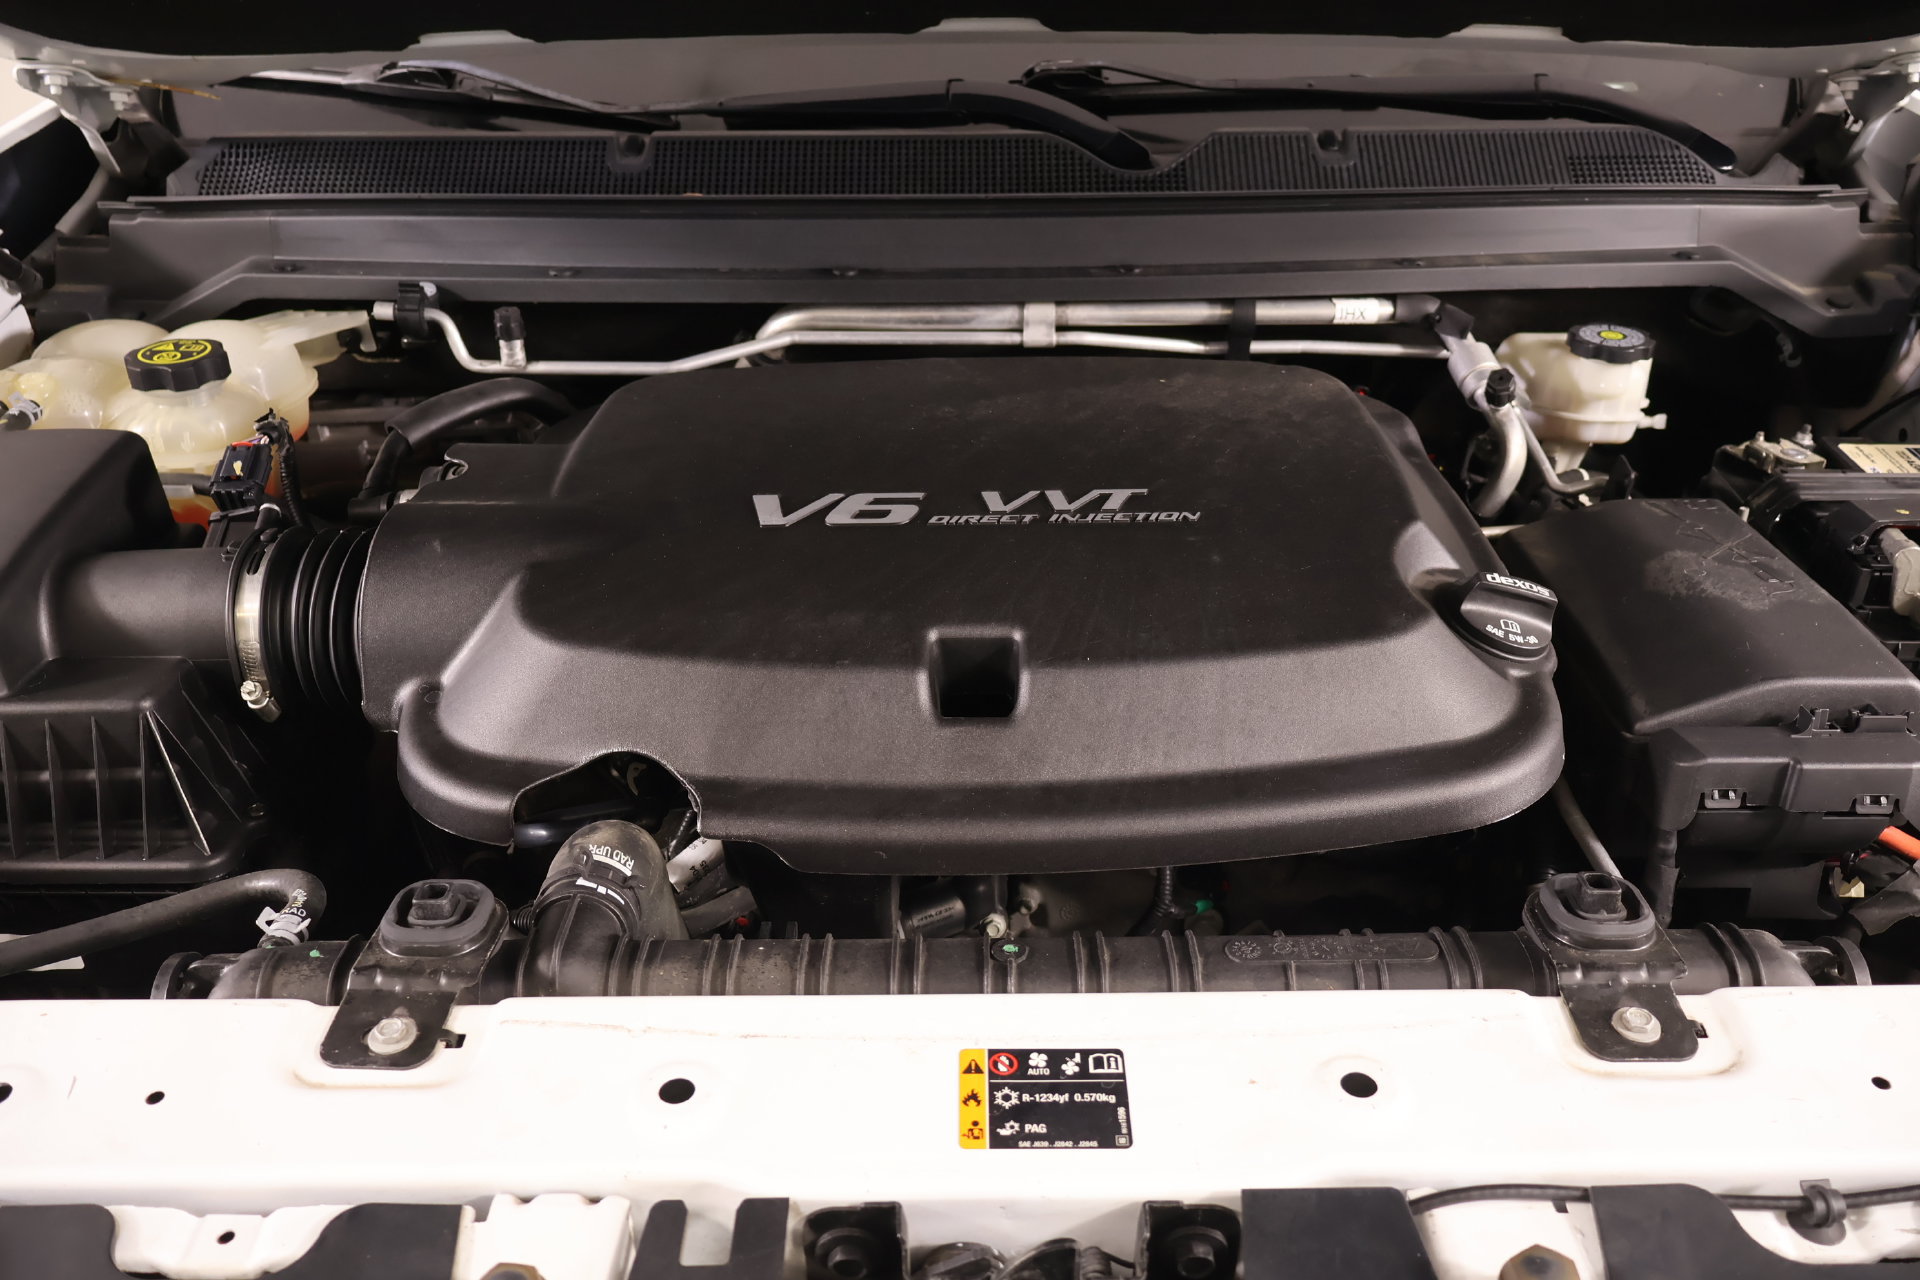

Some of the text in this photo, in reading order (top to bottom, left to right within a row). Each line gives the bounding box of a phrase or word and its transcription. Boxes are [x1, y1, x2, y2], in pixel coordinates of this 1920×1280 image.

[980, 488, 1149, 513] VVT
[752, 492, 926, 528] V6
[926, 511, 1201, 526] DIRECT INJECTION
[1485, 572, 1551, 597] dexos
[1485, 624, 1505, 638] SAE
[613, 850, 635, 871] RAD
[1027, 1067, 1050, 1076] AUTO
[1022, 1093, 1117, 1104] R-1234yf 0.570kg
[1024, 1123, 1048, 1134] PAG
[1018, 1140, 1032, 1148] SAE
